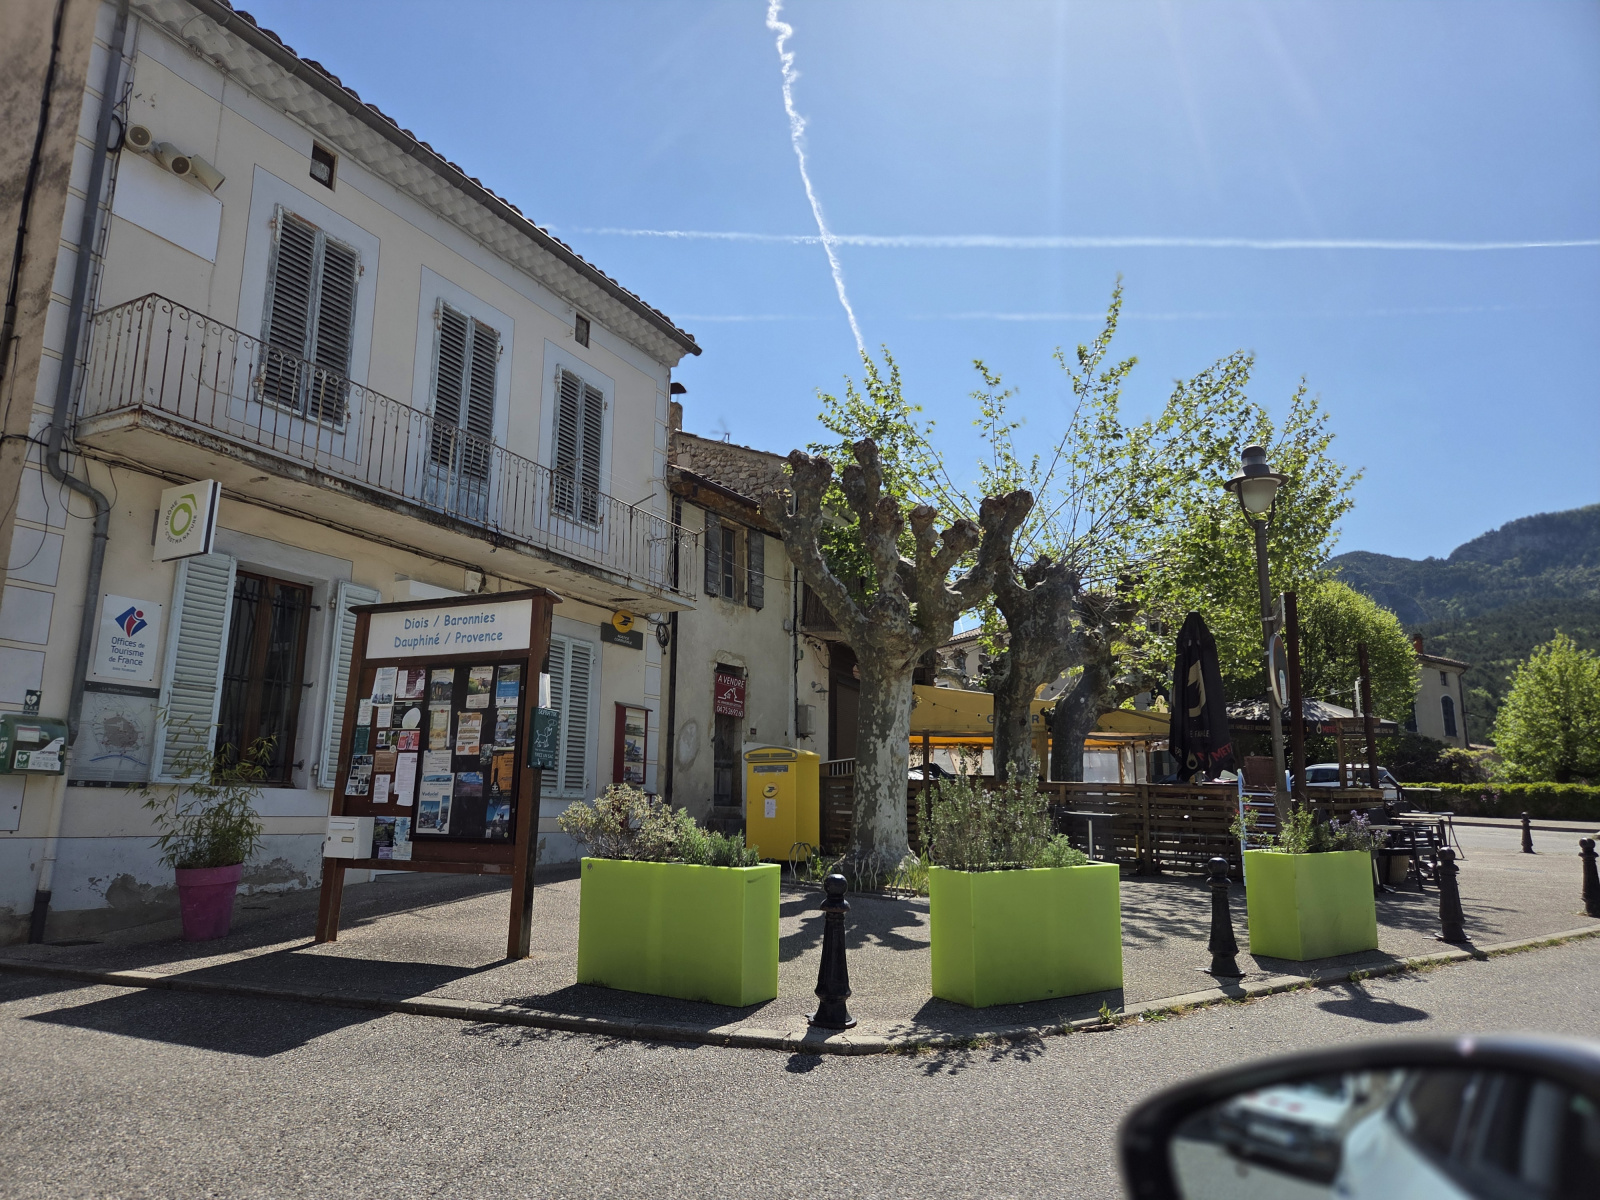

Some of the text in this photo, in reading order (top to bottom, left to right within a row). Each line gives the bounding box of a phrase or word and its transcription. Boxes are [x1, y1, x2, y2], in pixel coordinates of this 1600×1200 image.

[183, 514, 197, 540] NATURE
[404, 612, 496, 630] Diois / Baronnies
[111, 636, 137, 647] Offices
[394, 631, 503, 650] Dauphiné / Provence
[111, 645, 144, 657] Tourisme
[118, 656, 143, 666] France
[718, 674, 745, 688] A VENDRE
